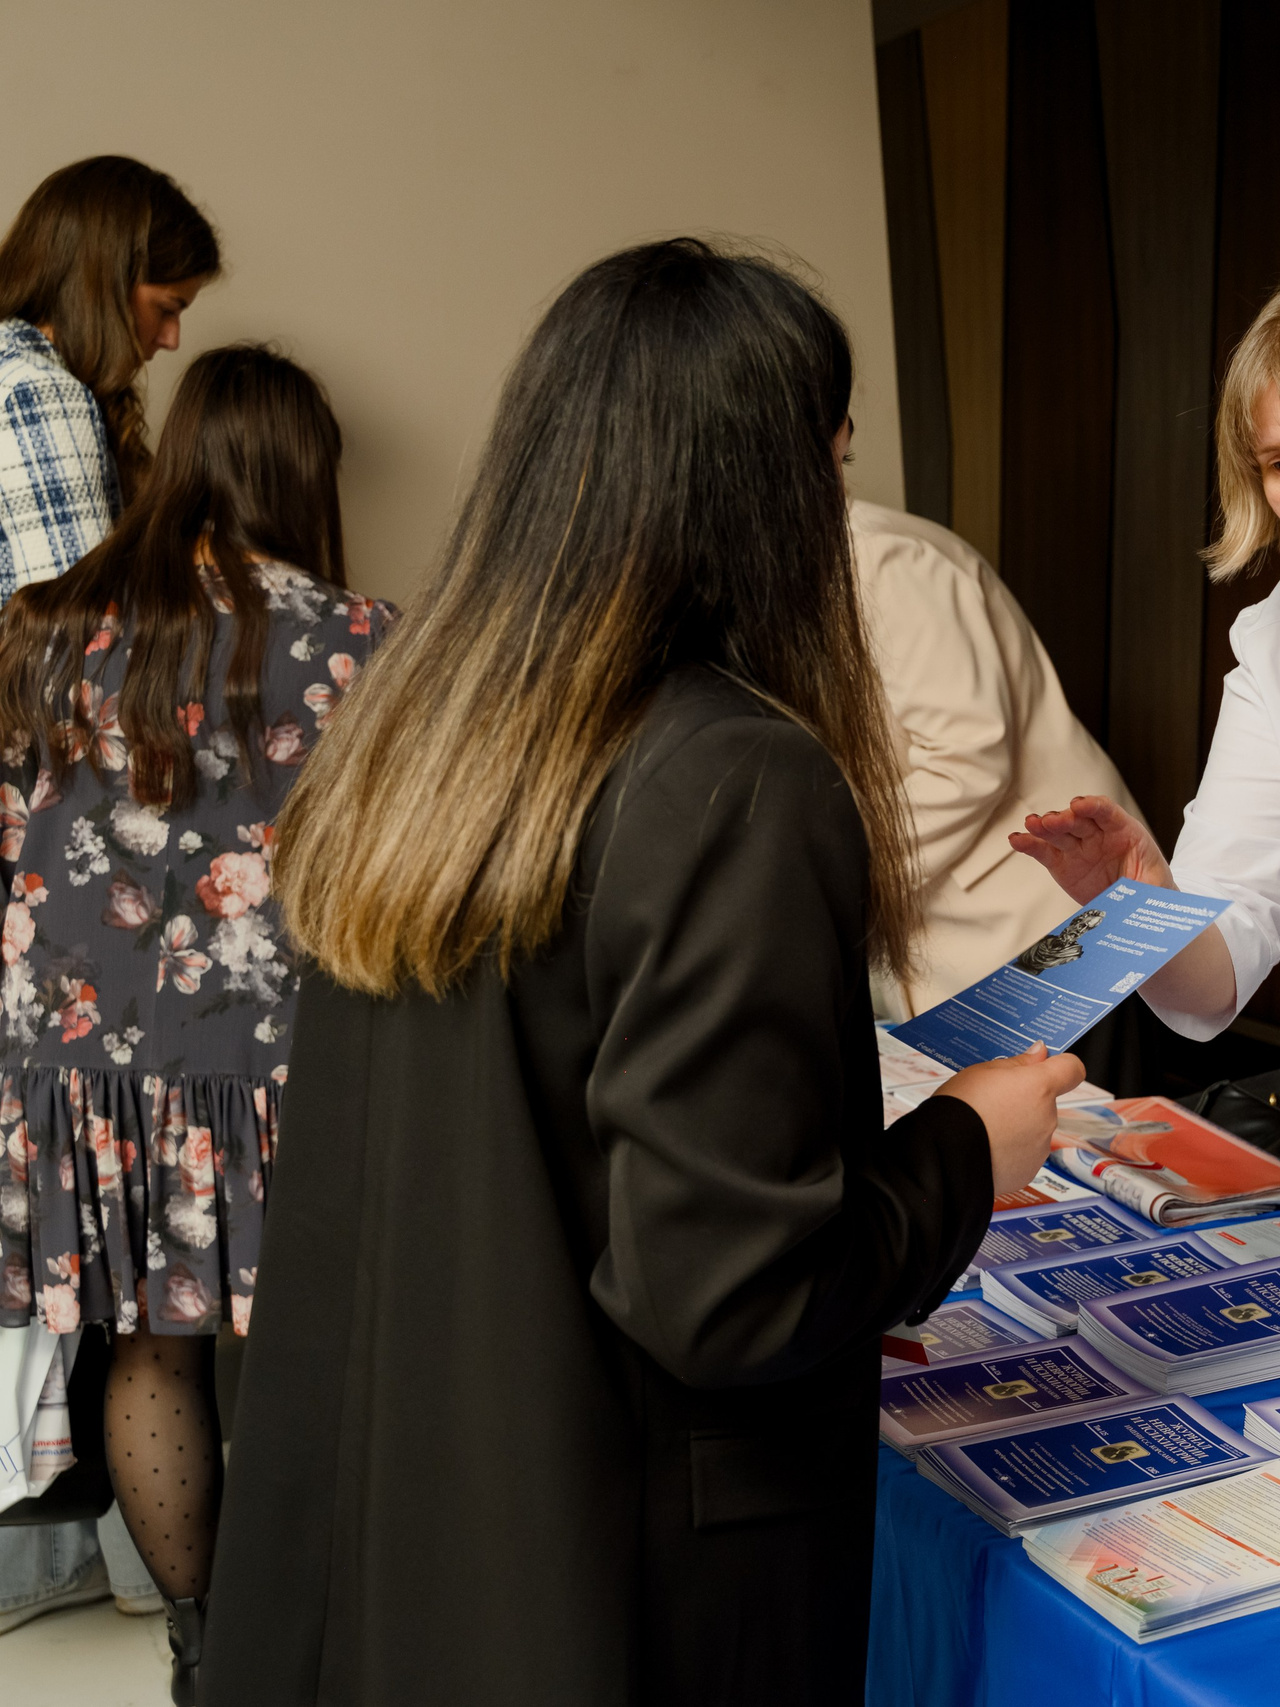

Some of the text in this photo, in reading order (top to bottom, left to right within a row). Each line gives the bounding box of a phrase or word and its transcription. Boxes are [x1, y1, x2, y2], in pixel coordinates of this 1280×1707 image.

[1136, 1424, 1203, 1463] ПСИХИАТРИИ
[1146, 1419, 1211, 1457] НЕВРОЛОГИИ
[1168, 1423, 1215, 1448] ЖУРНАЛ
